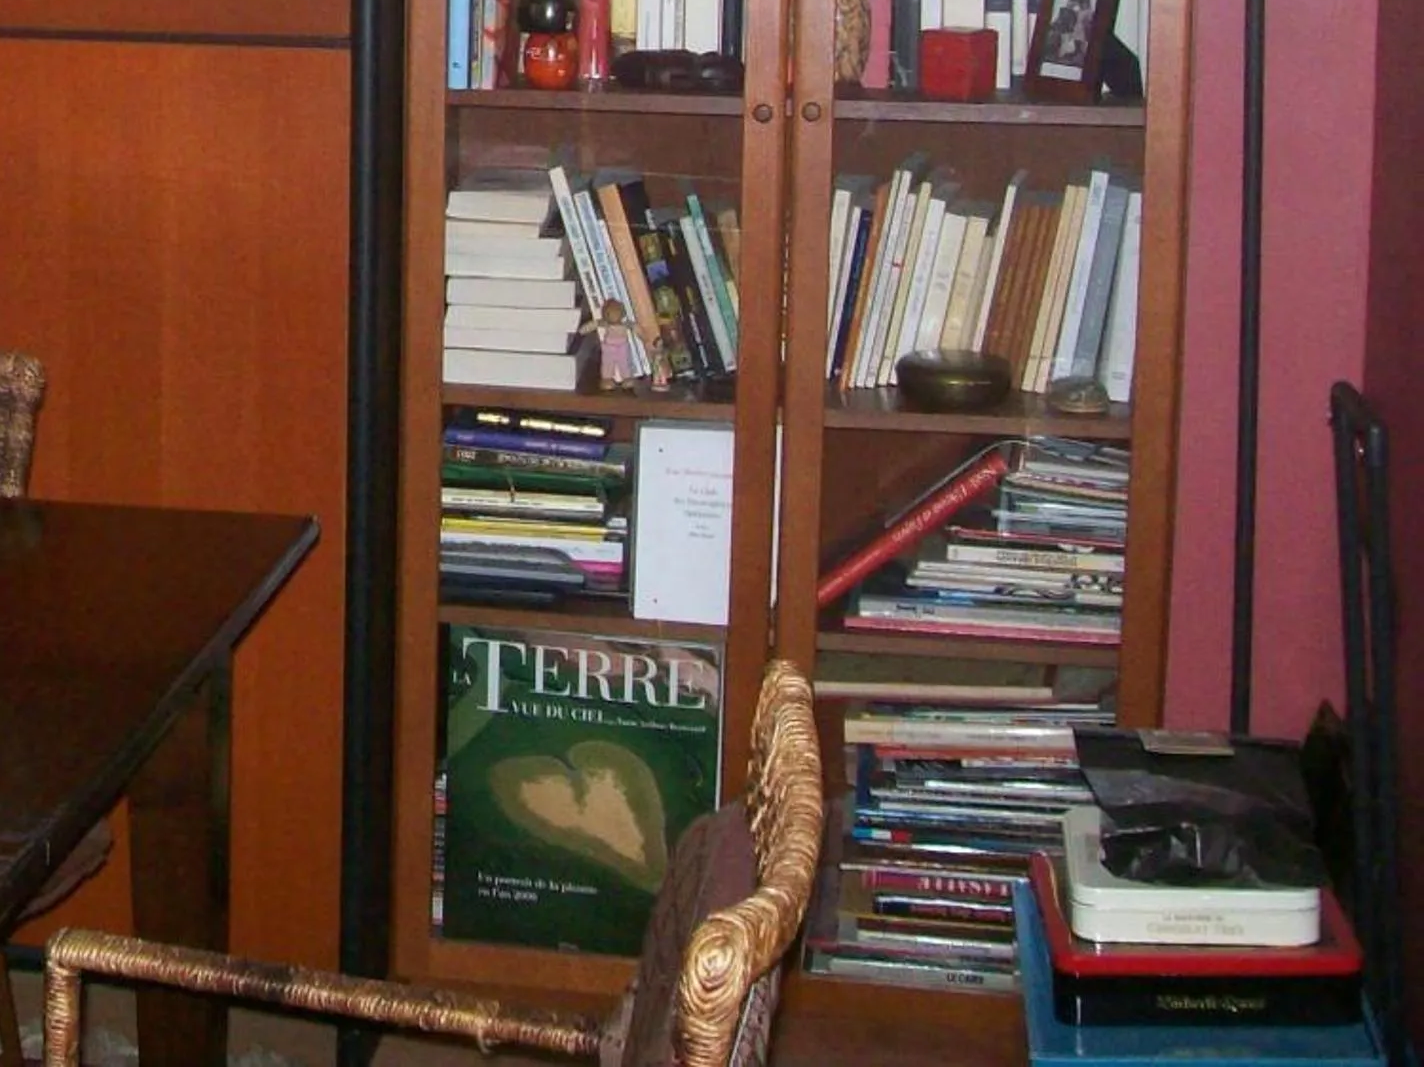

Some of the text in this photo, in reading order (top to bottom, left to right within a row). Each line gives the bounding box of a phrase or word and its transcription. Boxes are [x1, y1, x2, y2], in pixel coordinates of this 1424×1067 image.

[461, 636, 707, 713] TERRE
[510, 700, 541, 718] VUE
[545, 702, 570, 721] DU
[571, 706, 605, 724] CIEL
